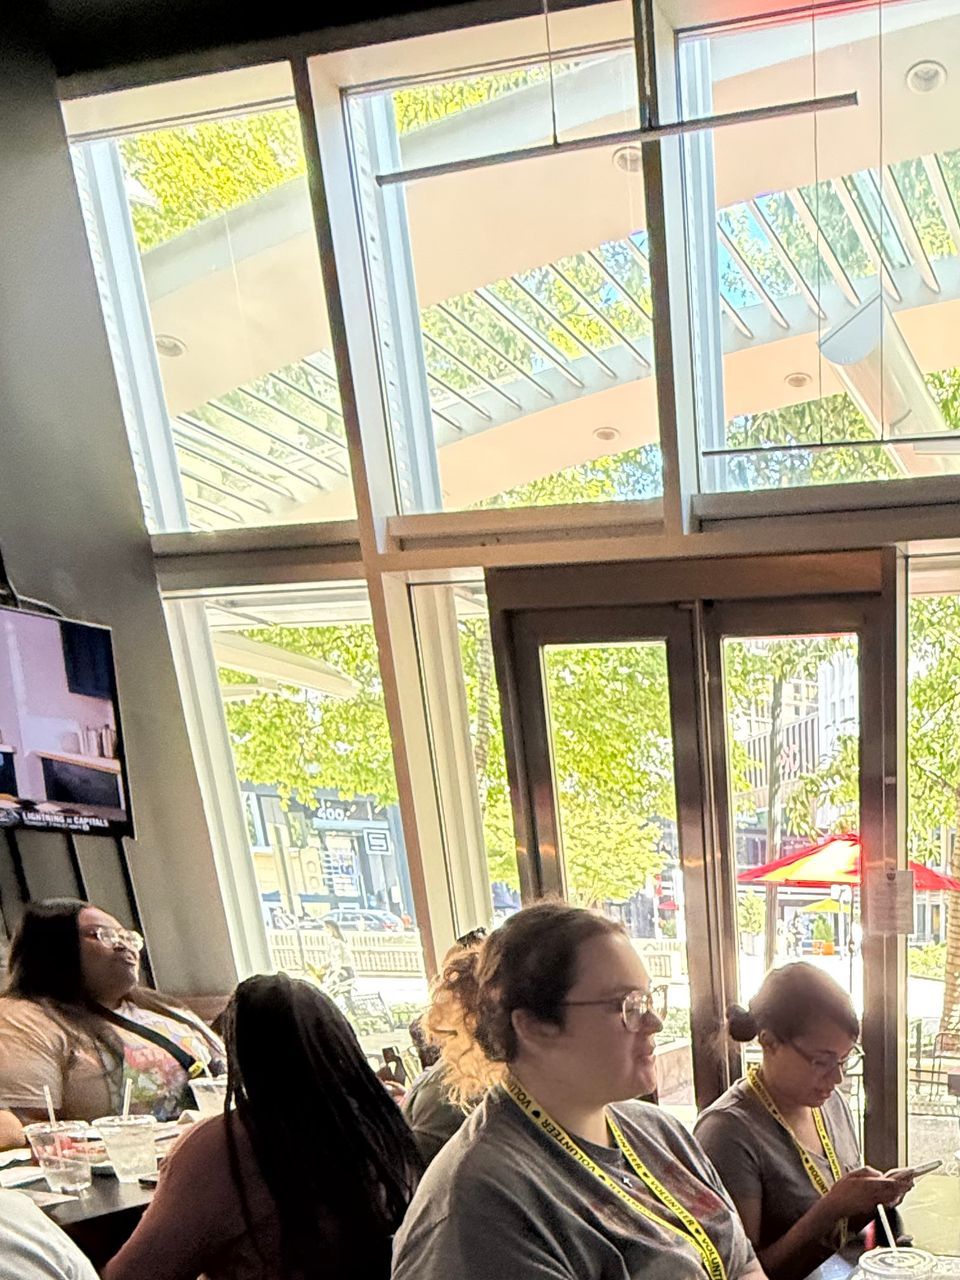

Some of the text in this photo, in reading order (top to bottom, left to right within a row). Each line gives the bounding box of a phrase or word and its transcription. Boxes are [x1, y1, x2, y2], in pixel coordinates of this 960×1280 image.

[74, 816, 109, 827] CAPITALS
[541, 1119, 596, 1172] VOLUNTEER
[651, 1181, 695, 1227] VOLUNTEER
